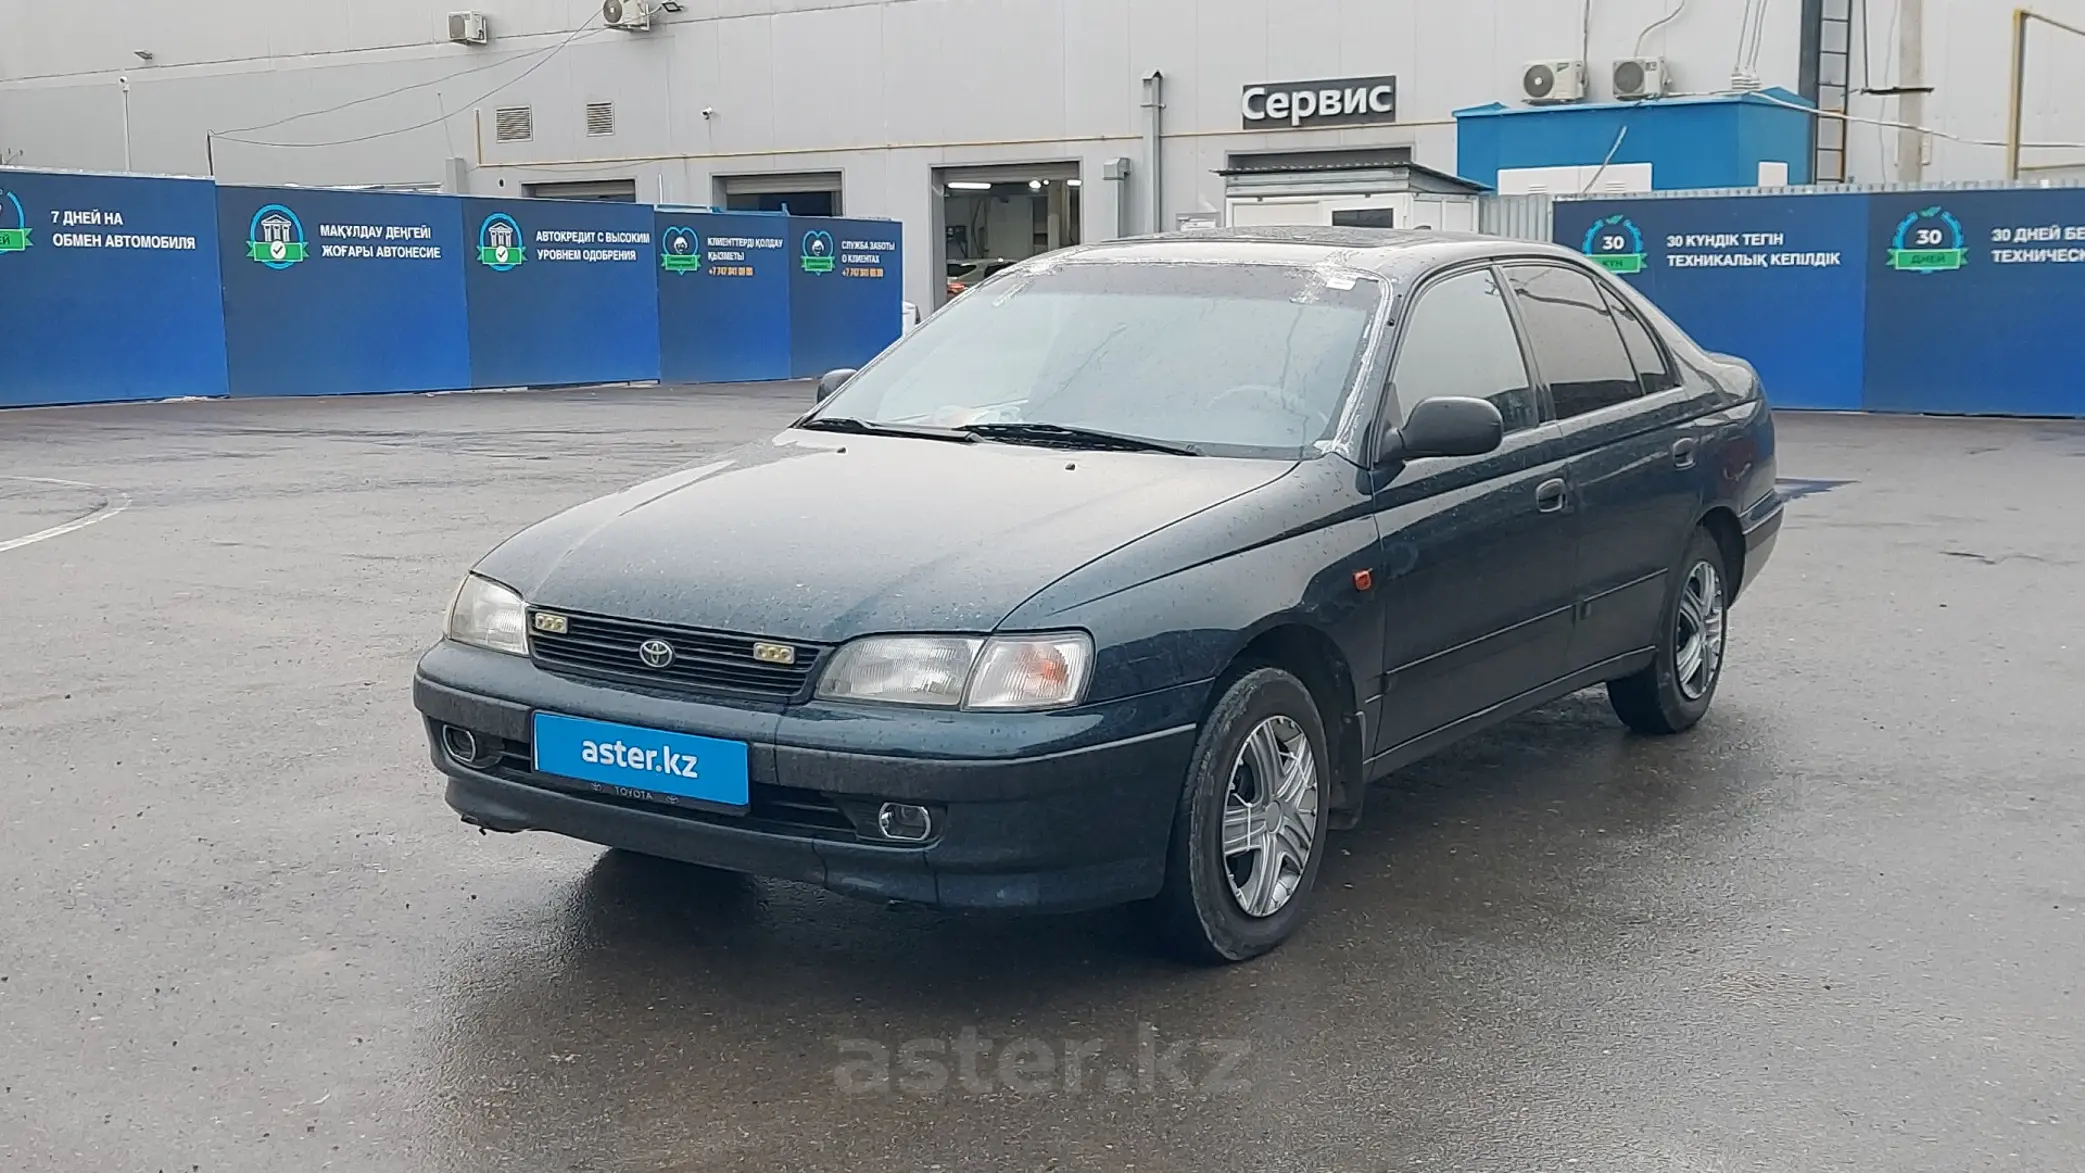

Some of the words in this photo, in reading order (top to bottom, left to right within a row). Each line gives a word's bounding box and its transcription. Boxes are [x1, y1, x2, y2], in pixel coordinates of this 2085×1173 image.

[1242, 85, 1391, 126] Сервис
[51, 211, 59, 223] 7
[63, 209, 101, 226] ДНЕЙ
[104, 212, 123, 225] НА
[320, 225, 383, 239] МАҚҰЛДАУ
[385, 225, 431, 240] ДЕҢГЕЙІ
[536, 231, 596, 244] АВТОКРЕДИТ
[597, 232, 604, 243] С
[605, 232, 650, 244] ВЫСОКИМ
[1916, 230, 1942, 244] 30
[1991, 228, 2010, 241] 30
[2013, 225, 2060, 243] ДНЕЙ
[53, 233, 102, 247] ОБМЕН
[105, 234, 196, 250] АВТОМОБИЛЯ
[842, 241, 868, 250] СЛУЖБА
[870, 242, 895, 251] ЗАБОТЫ
[1602, 236, 1625, 250] 30
[1666, 235, 1683, 247] 30
[1686, 234, 1739, 248] КҮНДІК
[1742, 233, 1784, 245] ТЕГІН
[322, 245, 374, 258] ЖОҒАРЫ
[376, 246, 441, 259] АВТОНЕСИЕ
[537, 249, 581, 260] УРОВНЕМ
[583, 250, 636, 262] ОДОБРЕНИЯ
[848, 254, 880, 263] КЛИЕНТАХ
[1911, 254, 1946, 264] ДНЕЙ
[1667, 254, 1768, 267] ТЕХНИКАЛЫҚ
[1770, 252, 1841, 267] КЕПІЛДІК
[582, 740, 698, 778] aster.kz
[615, 786, 654, 799] TOYOTA
